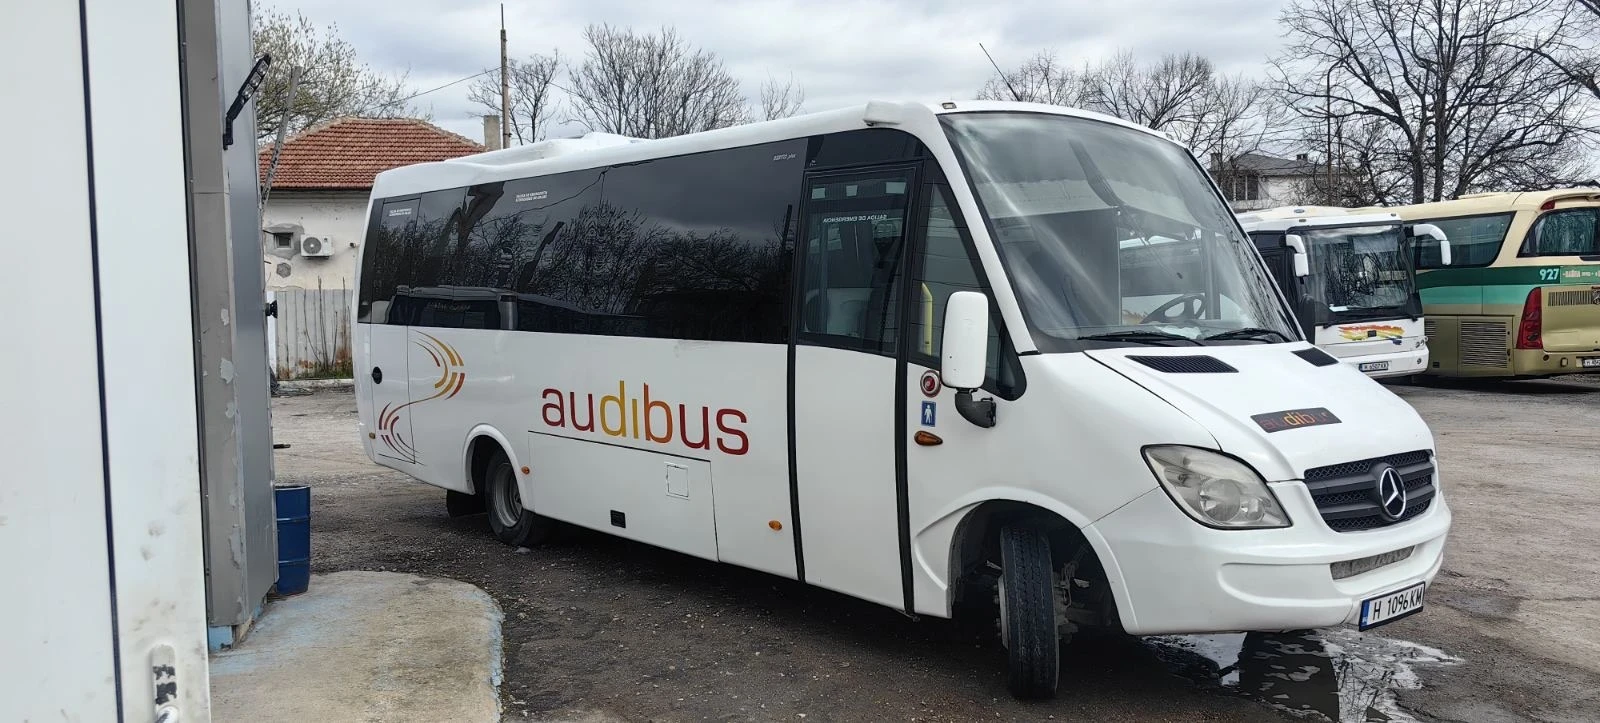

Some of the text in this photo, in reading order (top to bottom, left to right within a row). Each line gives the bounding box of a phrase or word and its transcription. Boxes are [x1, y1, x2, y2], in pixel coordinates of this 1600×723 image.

[1539, 268, 1560, 281] 927
[541, 380, 750, 456] audibus
[1372, 600, 1382, 621] H
